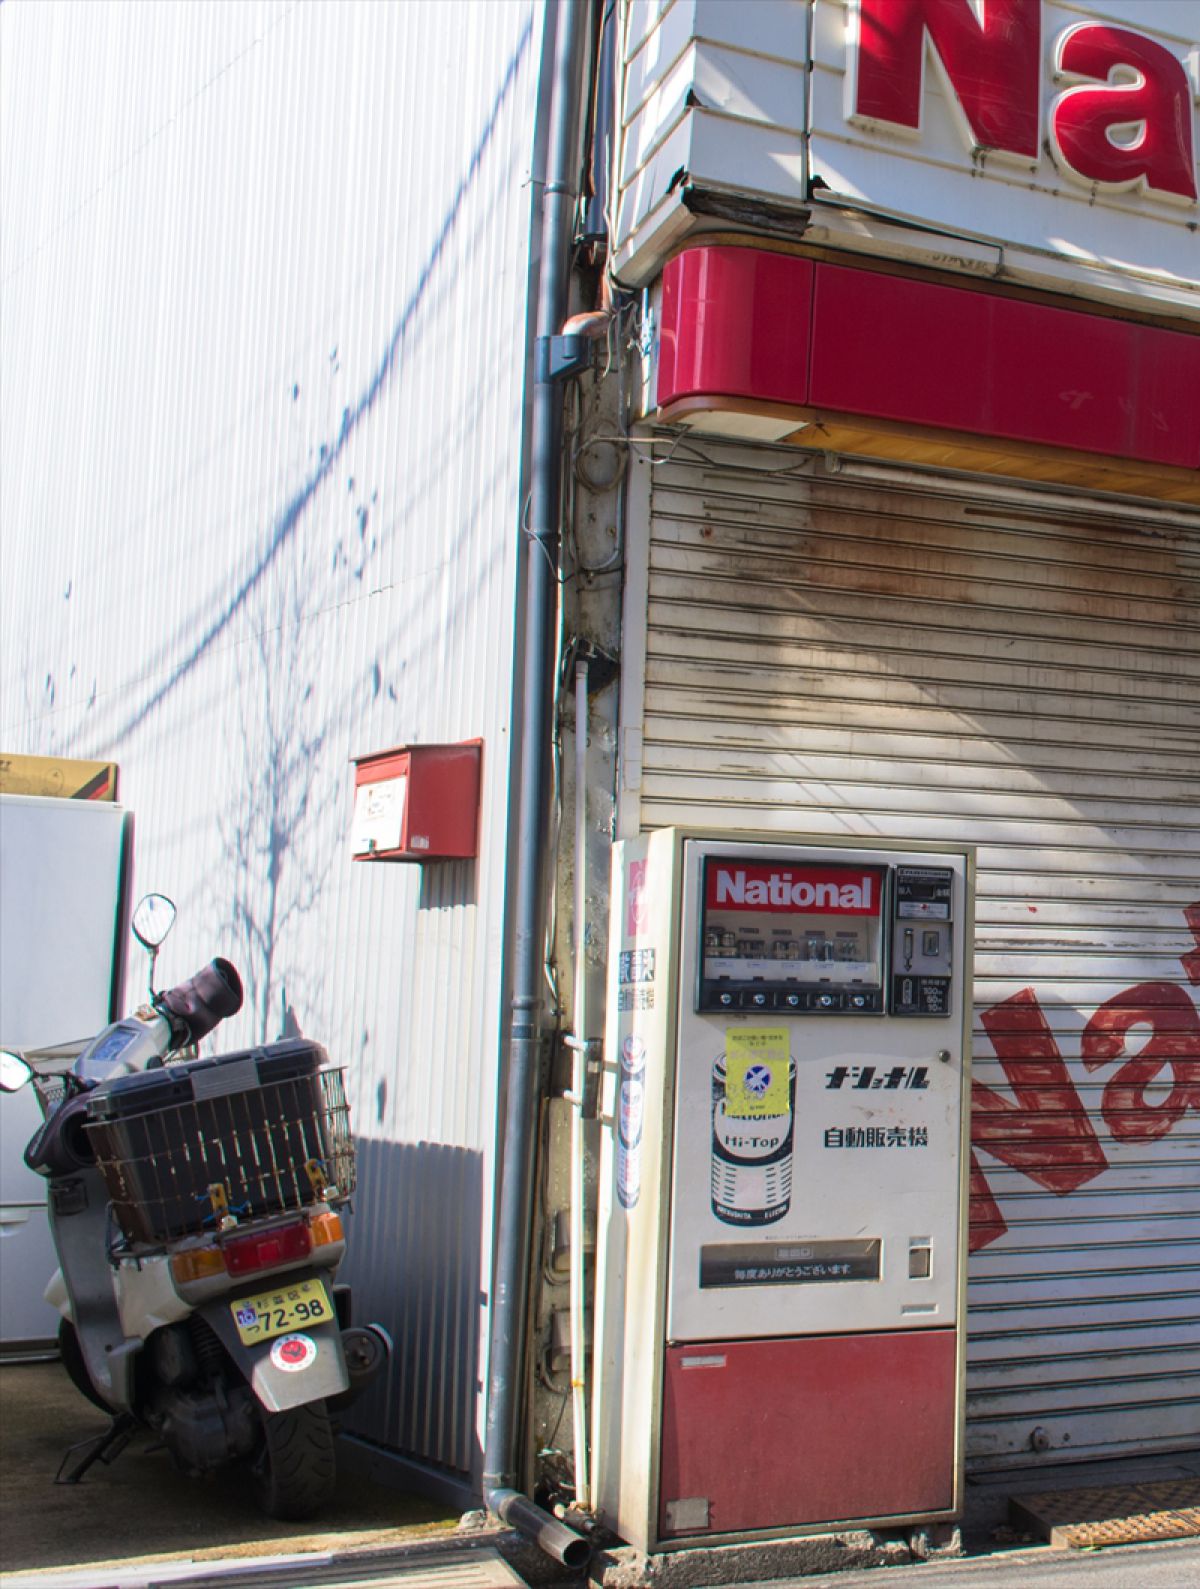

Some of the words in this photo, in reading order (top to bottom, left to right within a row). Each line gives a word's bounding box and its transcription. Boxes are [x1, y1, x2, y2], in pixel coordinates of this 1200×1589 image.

[716, 869, 872, 909] National
[825, 1066, 931, 1090] ナショナル
[725, 1135, 780, 1148] Hi-Top
[824, 1126, 929, 1148] 自動販売機
[734, 1263, 851, 1281] 毎度ありがとうございます
[258, 1299, 324, 1331] 72-98
